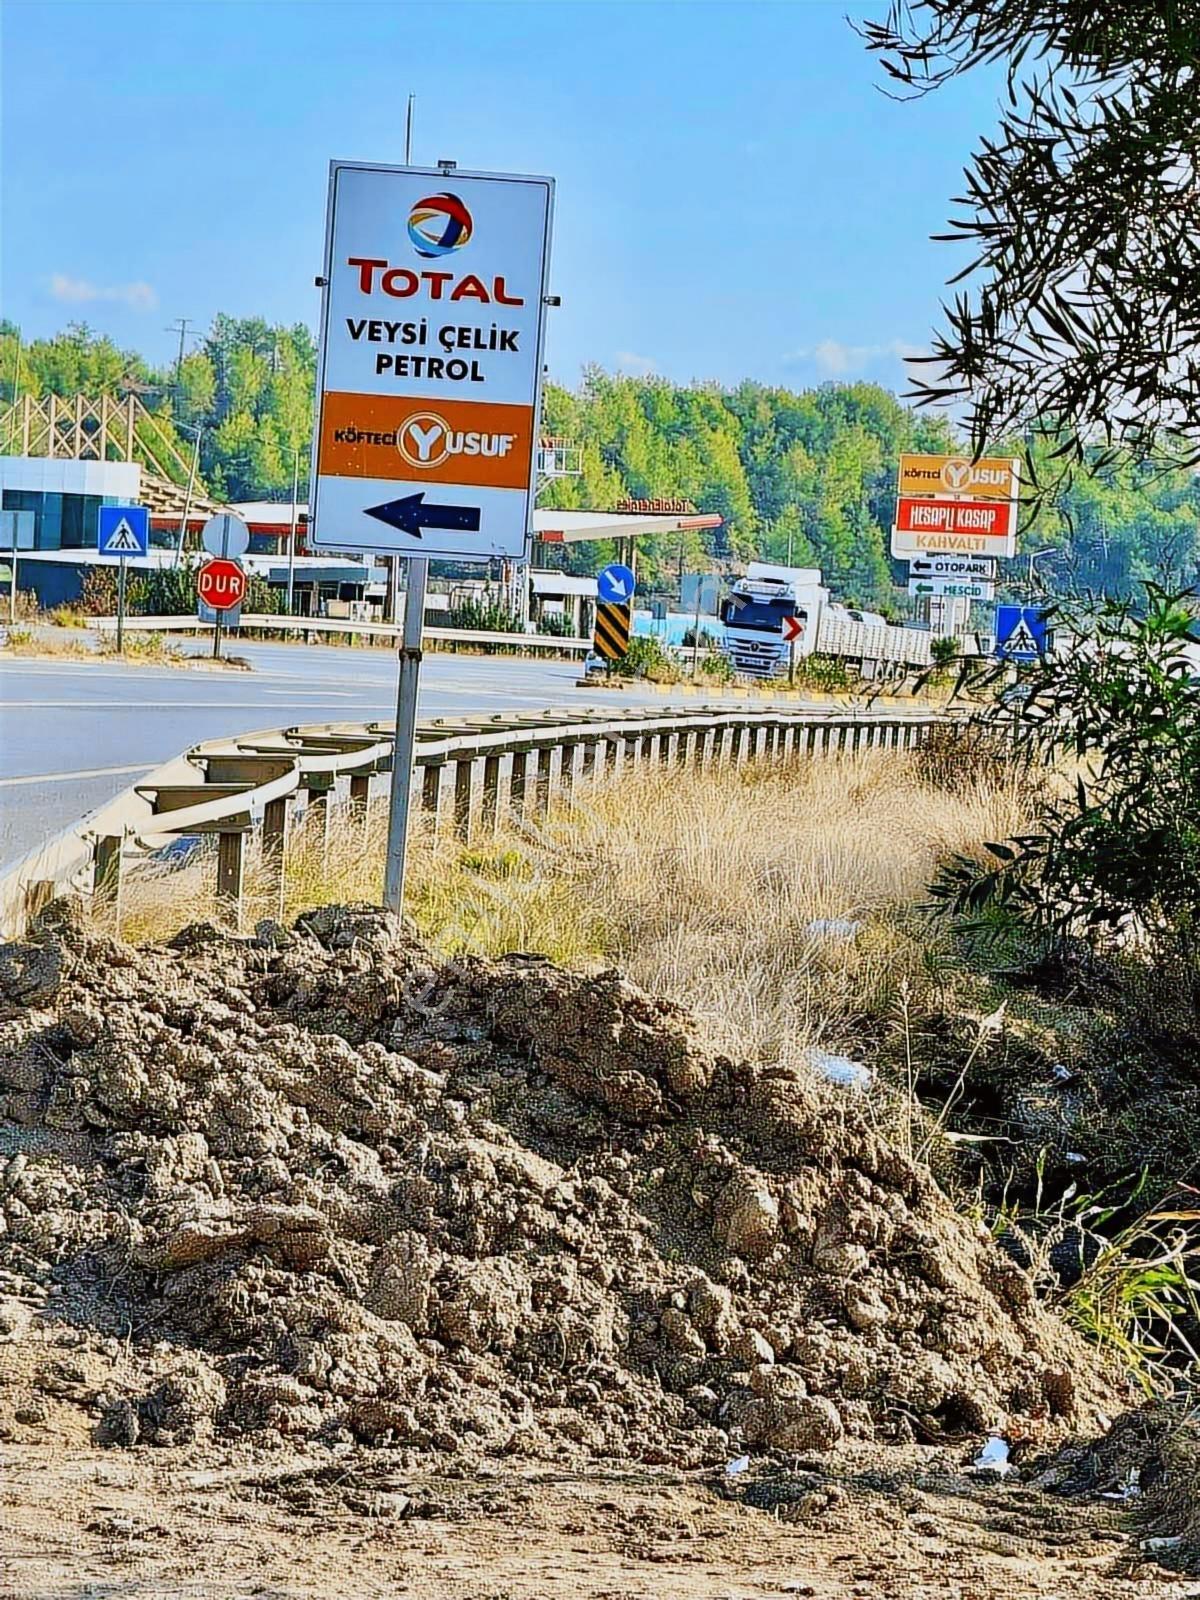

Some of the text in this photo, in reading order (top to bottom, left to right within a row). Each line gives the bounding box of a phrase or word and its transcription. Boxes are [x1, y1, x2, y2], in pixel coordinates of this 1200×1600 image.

[348, 258, 524, 306] TOTAL
[346, 318, 520, 353] VEYSİ ÇELİK
[376, 353, 485, 382] PETROL
[334, 421, 514, 463] KÖFTECİ YUSUF
[903, 464, 1010, 487] KÖFTECİ YUSUF
[910, 505, 996, 533] HESAPLI KASAP
[916, 535, 986, 551] KAHVALTI
[935, 562, 986, 574] OTOPARK
[202, 573, 240, 595] DUR
[943, 583, 982, 596] MESCİD
